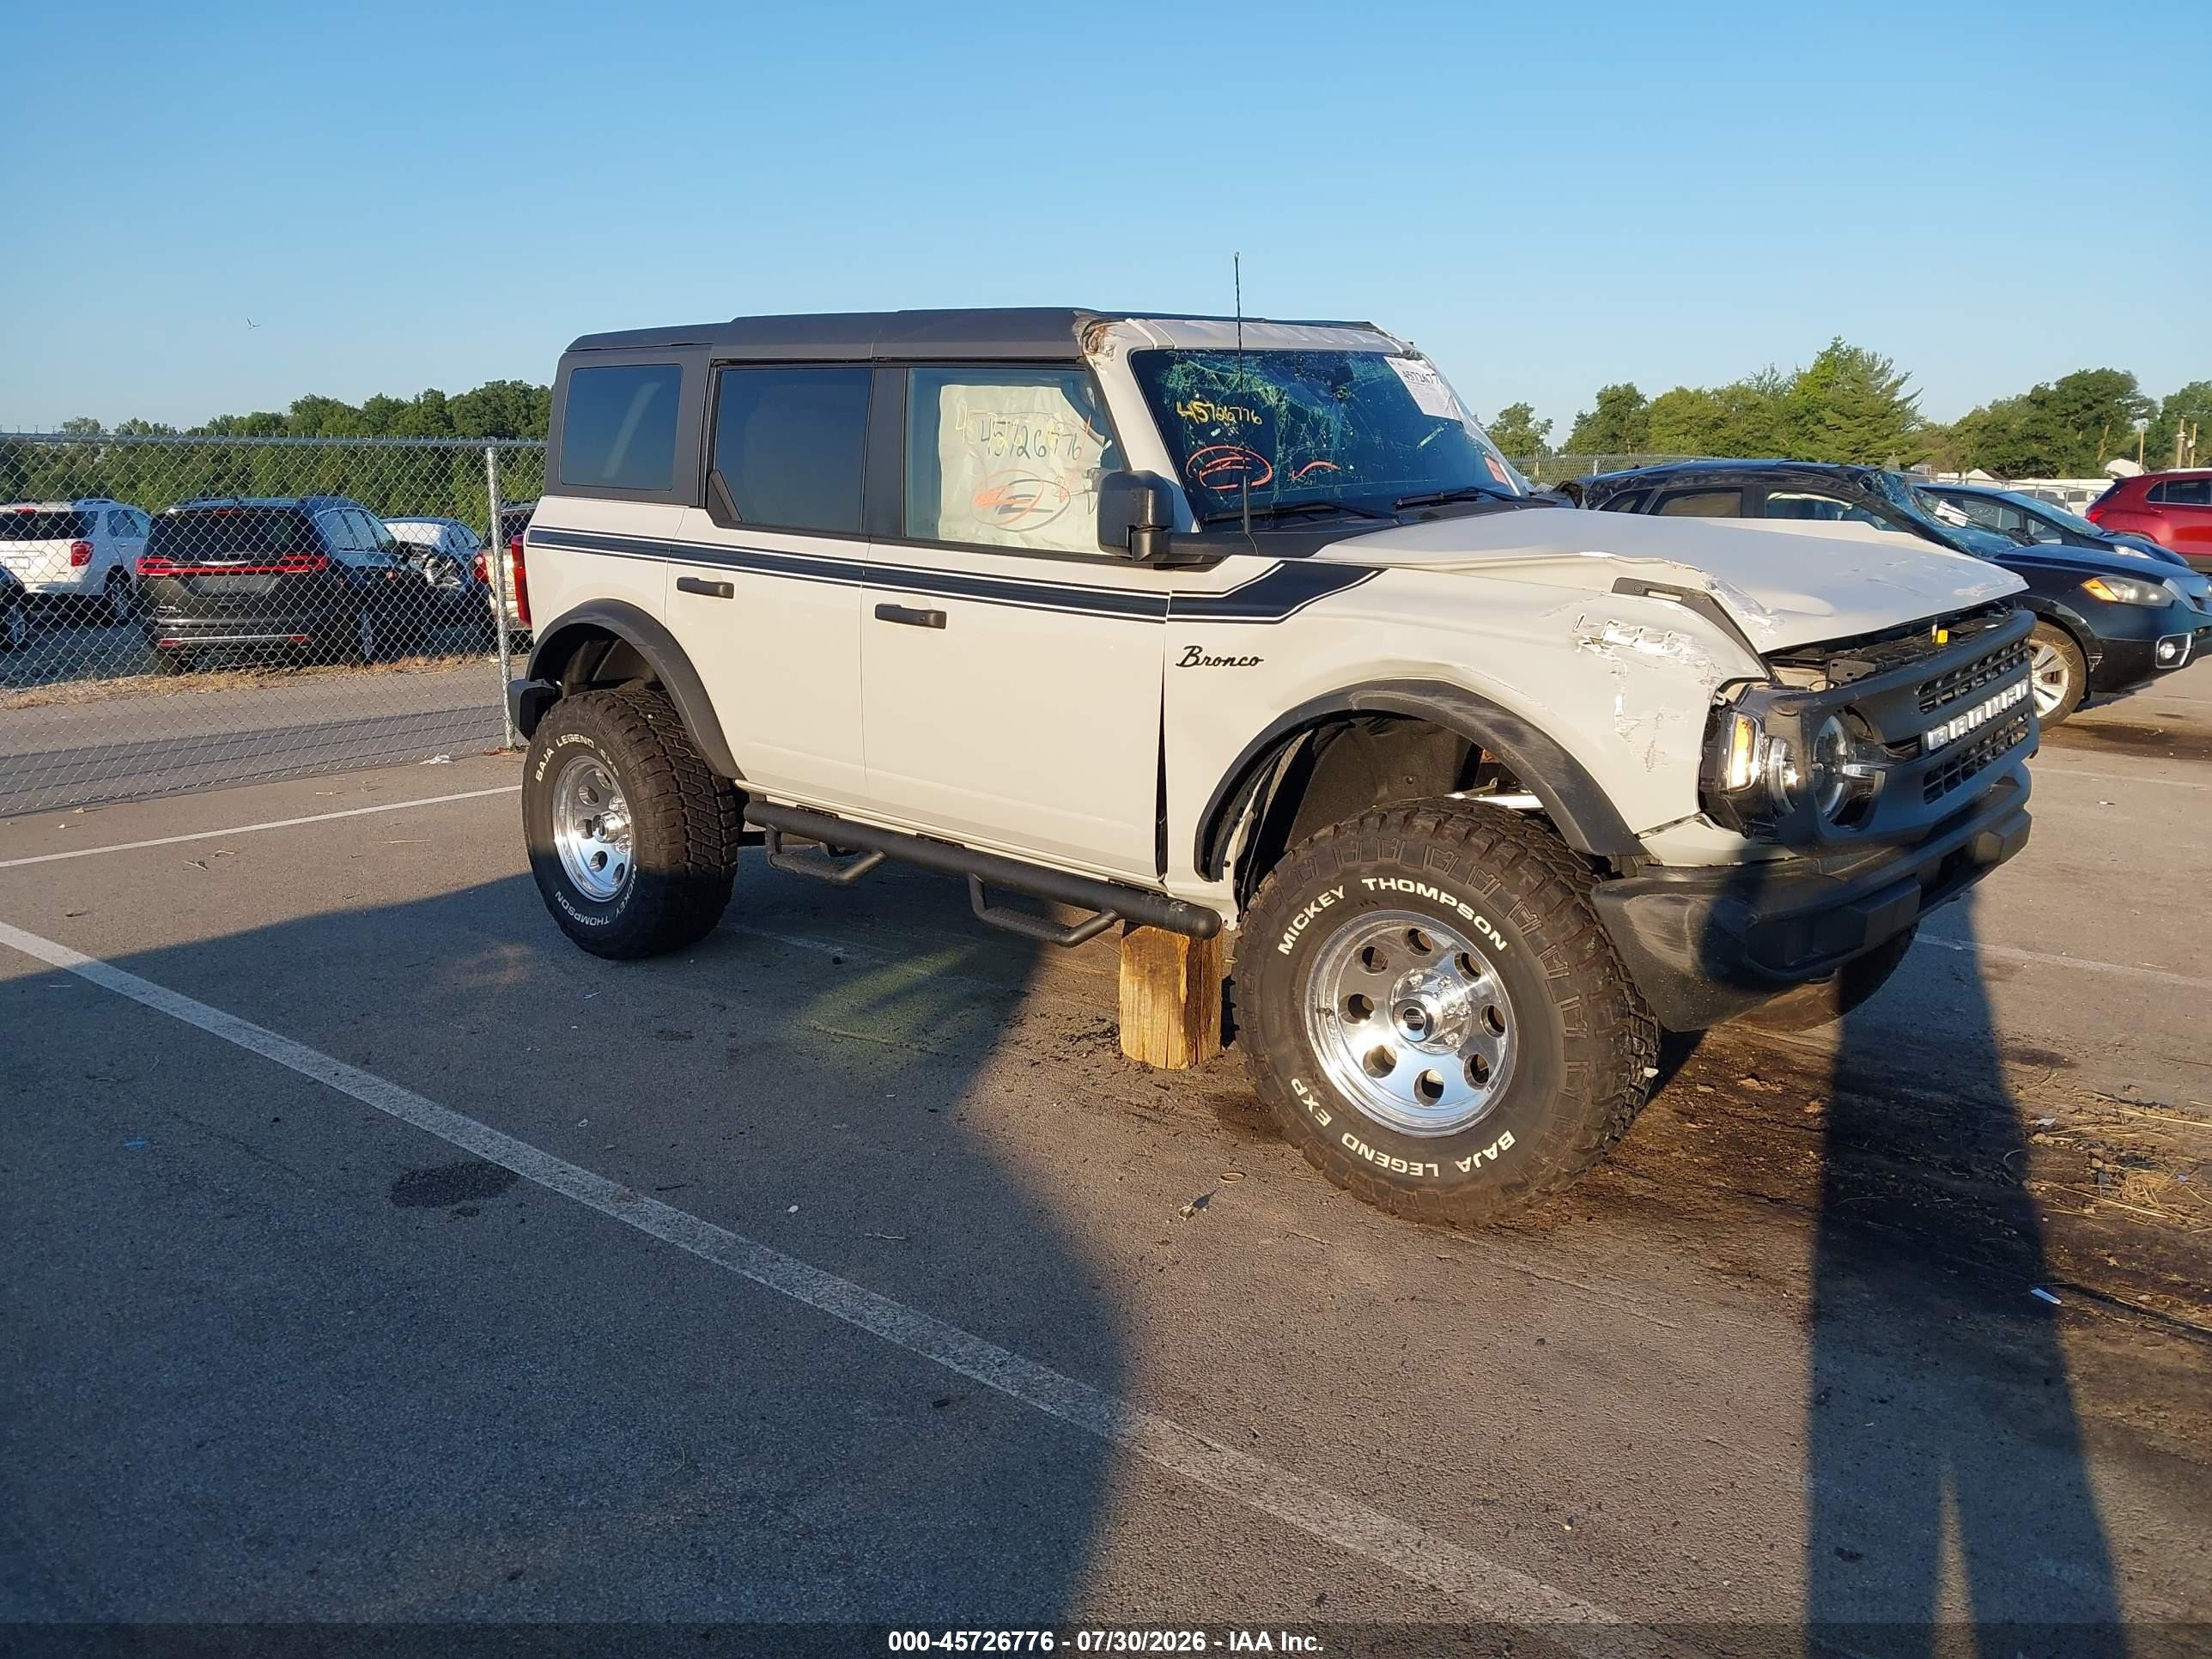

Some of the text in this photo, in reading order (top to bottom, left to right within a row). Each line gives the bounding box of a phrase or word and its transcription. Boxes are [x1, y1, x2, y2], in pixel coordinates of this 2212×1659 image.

[1176, 399, 1263, 425] 45726776
[1176, 646, 1264, 667] Bronco
[1928, 678, 2028, 750] BRONCO
[535, 734, 618, 782] BAJA LEGEND EXP
[555, 864, 638, 927] MICKEY THOMPSON
[1277, 878, 1508, 956] MICKEY THOMPSON
[1291, 1078, 1516, 1177] BAJA LEGEND EXP
